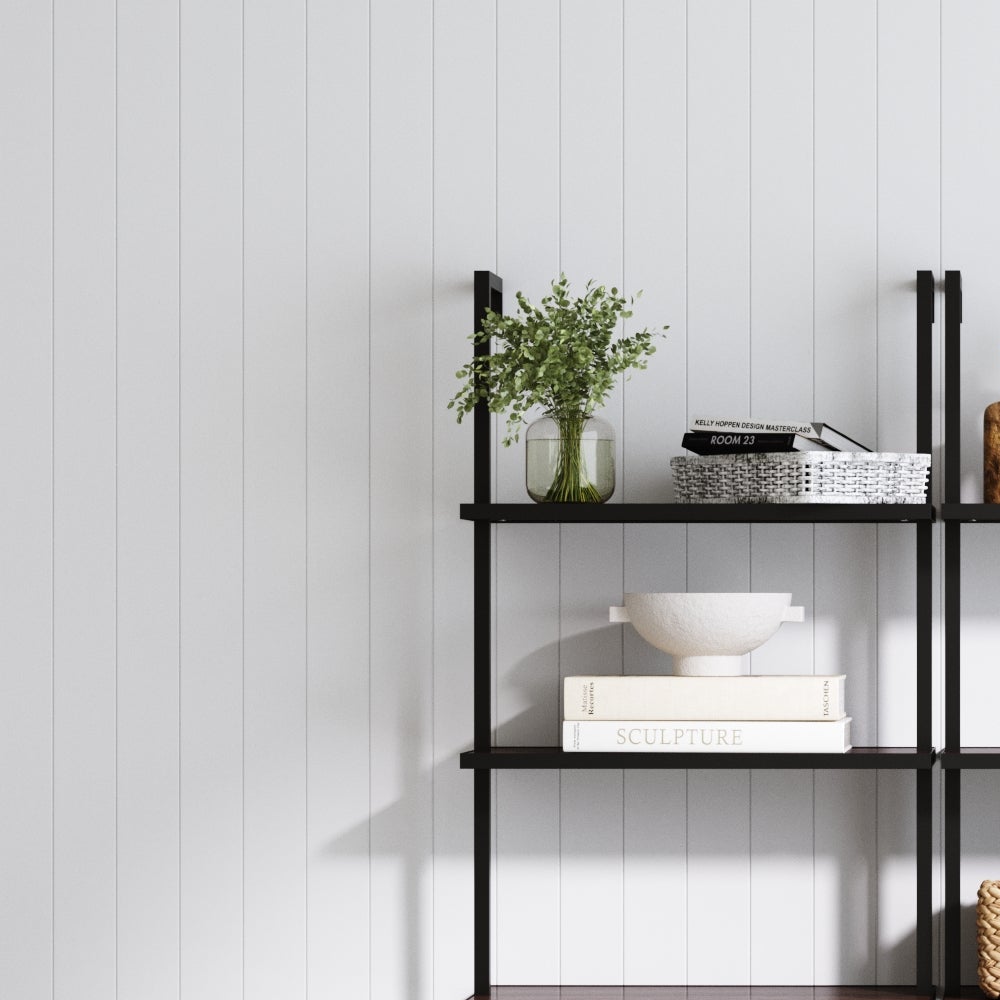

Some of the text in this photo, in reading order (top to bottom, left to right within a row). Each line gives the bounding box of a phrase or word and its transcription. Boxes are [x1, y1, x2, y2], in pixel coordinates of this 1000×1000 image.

[715, 421, 740, 429] HOPPEN
[741, 422, 764, 431] DESIGN
[765, 424, 811, 434] MASTERCLASS
[710, 435, 755, 445] ROOM 23
[616, 728, 743, 746] SCULPTURE
